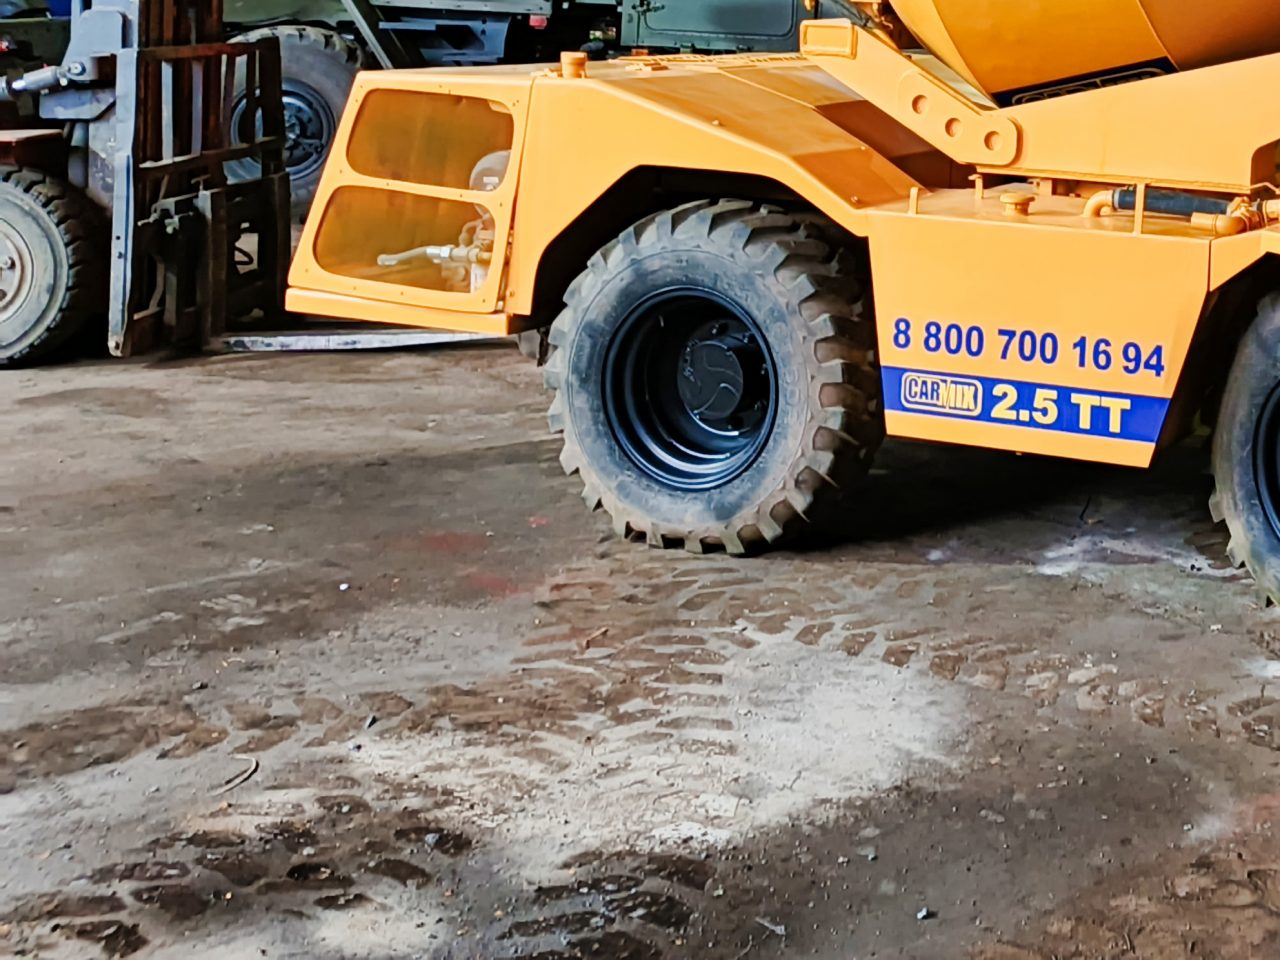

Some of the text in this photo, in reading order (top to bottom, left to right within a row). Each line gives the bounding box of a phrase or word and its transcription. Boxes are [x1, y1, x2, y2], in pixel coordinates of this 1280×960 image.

[893, 318, 1165, 378] 8 800 700 16 94
[907, 375, 1131, 434] CARMIX 2.5 TT
